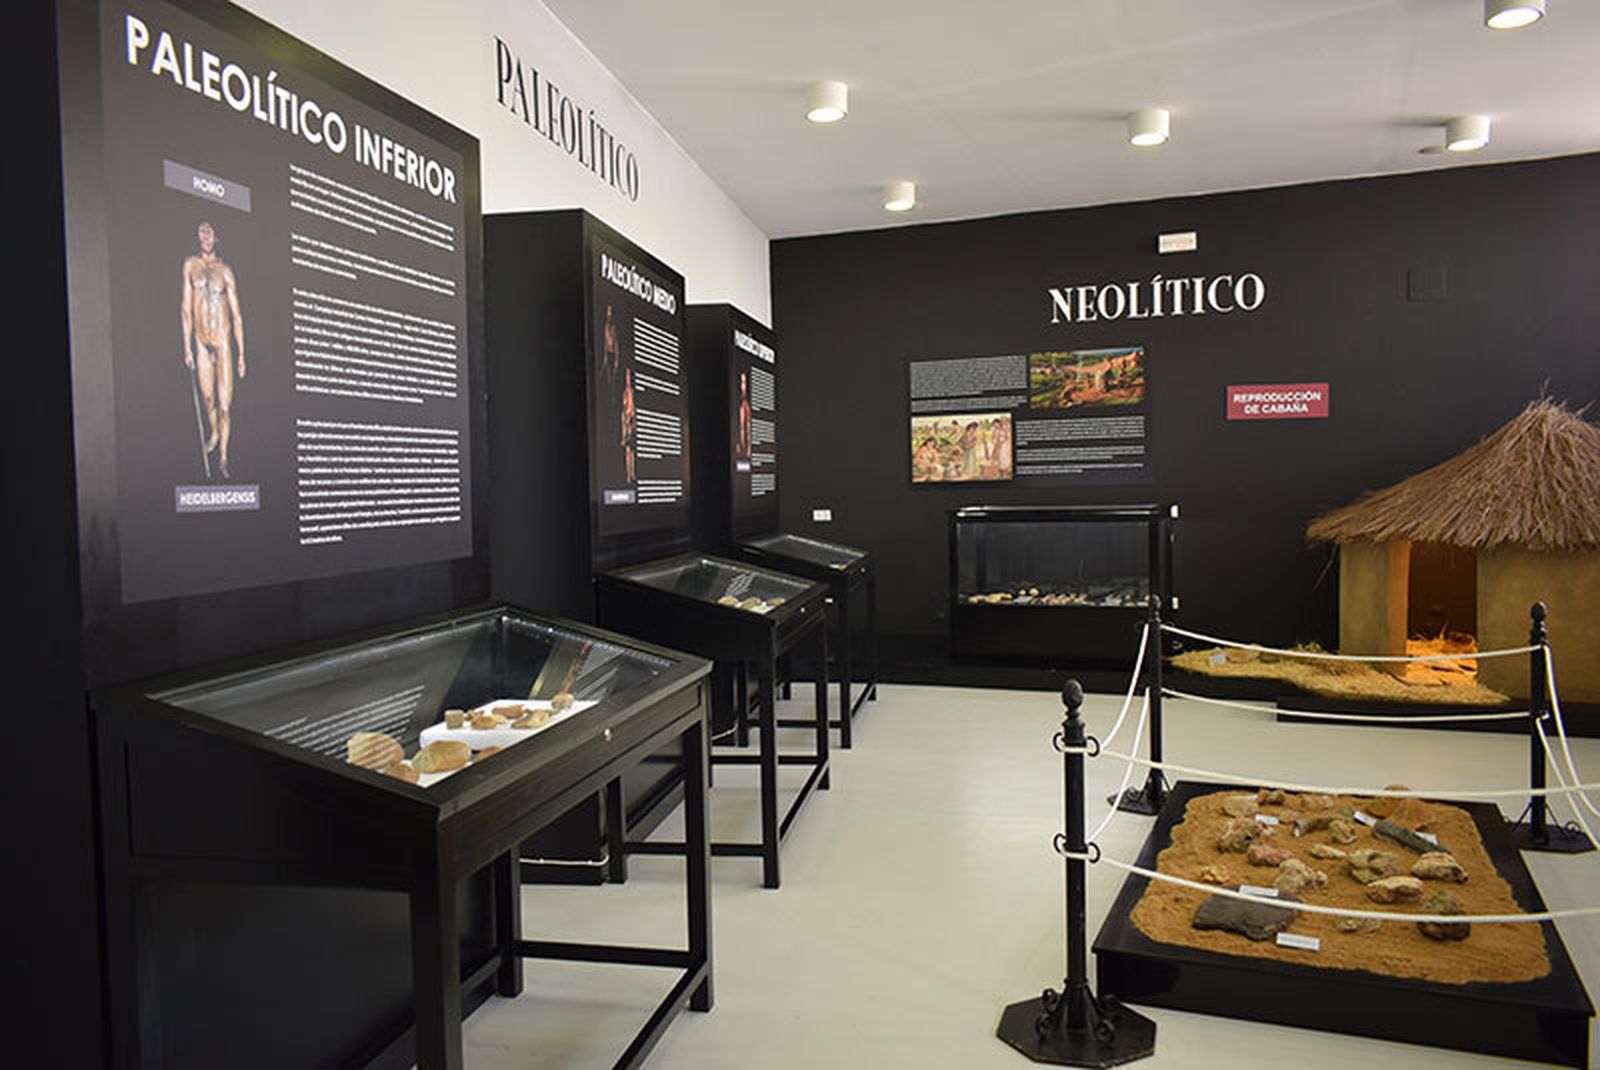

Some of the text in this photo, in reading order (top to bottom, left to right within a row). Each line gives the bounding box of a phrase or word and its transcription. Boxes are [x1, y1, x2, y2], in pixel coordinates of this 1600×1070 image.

[125, 14, 456, 203] PALEOLÍTICO INFERIOR
[494, 35, 639, 202] PALEOLÍTICO
[193, 175, 225, 198] HOMO
[1049, 273, 1265, 323] NEOLÍTICO
[1233, 390, 1321, 403] REPRODUCCIÓN
[1244, 403, 1309, 415] DE CABAÑA
